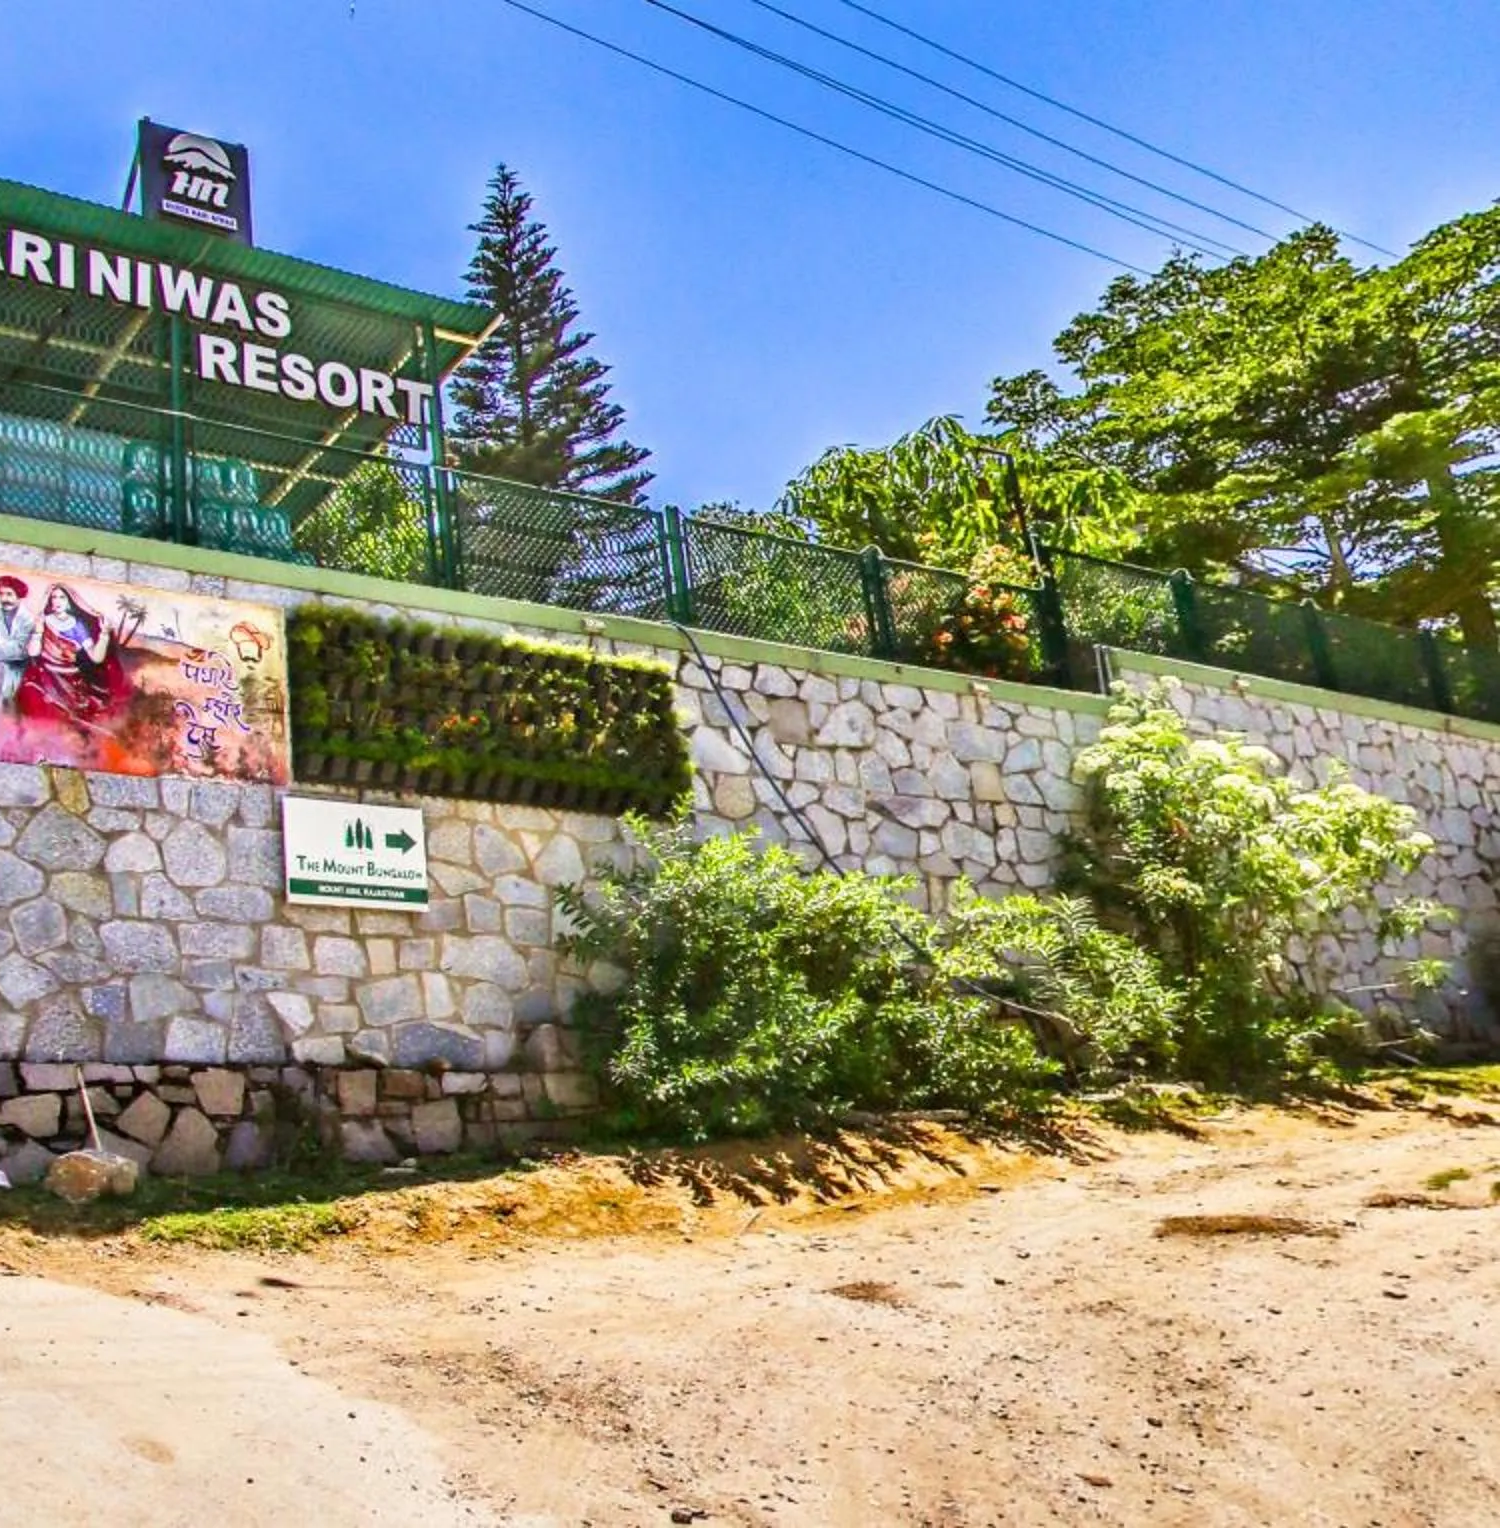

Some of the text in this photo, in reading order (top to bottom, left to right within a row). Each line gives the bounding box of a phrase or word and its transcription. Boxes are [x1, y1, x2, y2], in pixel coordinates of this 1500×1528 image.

[88, 249, 291, 338] NIWAS
[197, 333, 434, 426] RESORT
[296, 855, 320, 873] THE
[323, 858, 364, 875] MOUNT
